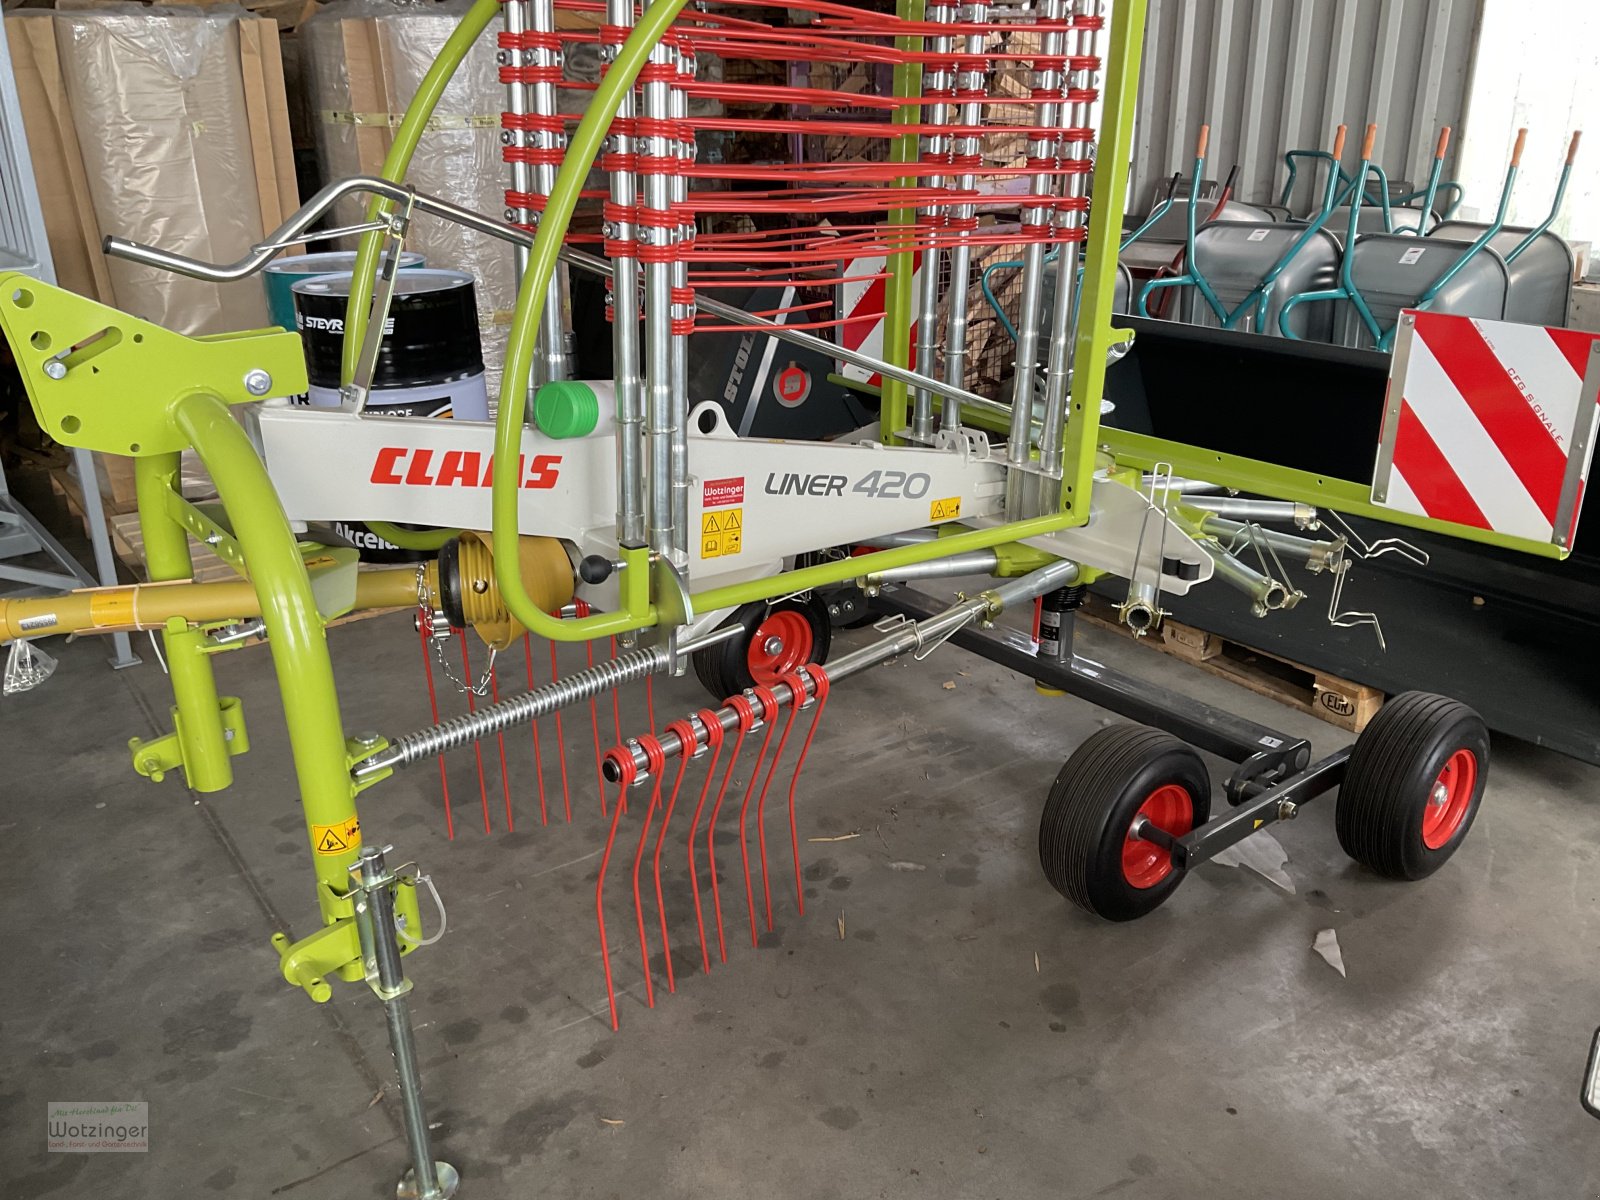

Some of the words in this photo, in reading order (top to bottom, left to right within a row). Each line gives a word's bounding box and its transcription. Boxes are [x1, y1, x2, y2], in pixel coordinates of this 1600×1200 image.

[306, 316, 343, 331] STEYR
[723, 331, 756, 404] STOL
[1507, 367, 1526, 391] CFG
[1525, 393, 1564, 444] SIGNALE
[704, 485, 744, 497] Wotzinger
[764, 472, 848, 497] LINER
[851, 470, 931, 499] 420
